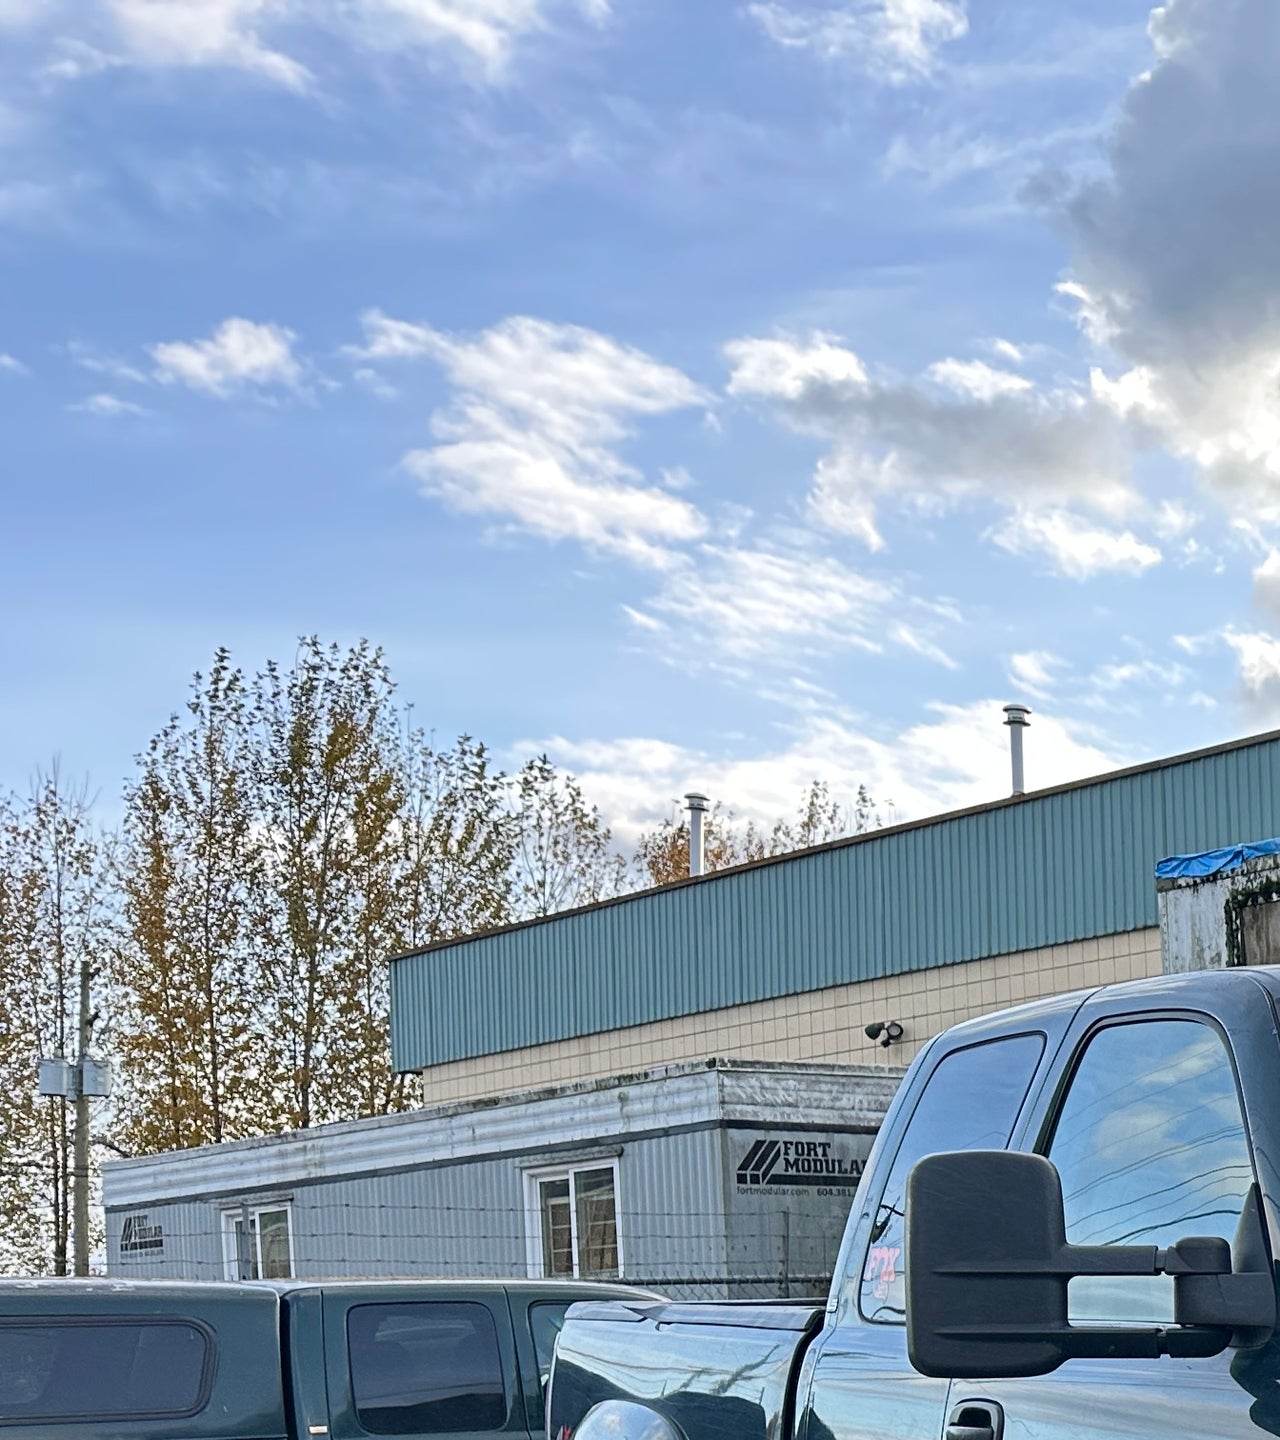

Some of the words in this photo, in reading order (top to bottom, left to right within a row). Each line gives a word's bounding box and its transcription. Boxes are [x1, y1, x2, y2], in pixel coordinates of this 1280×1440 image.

[782, 1140, 831, 1158] FORT
[783, 1157, 867, 1175] MODULA
[736, 1186, 809, 1197] fortmodular.com
